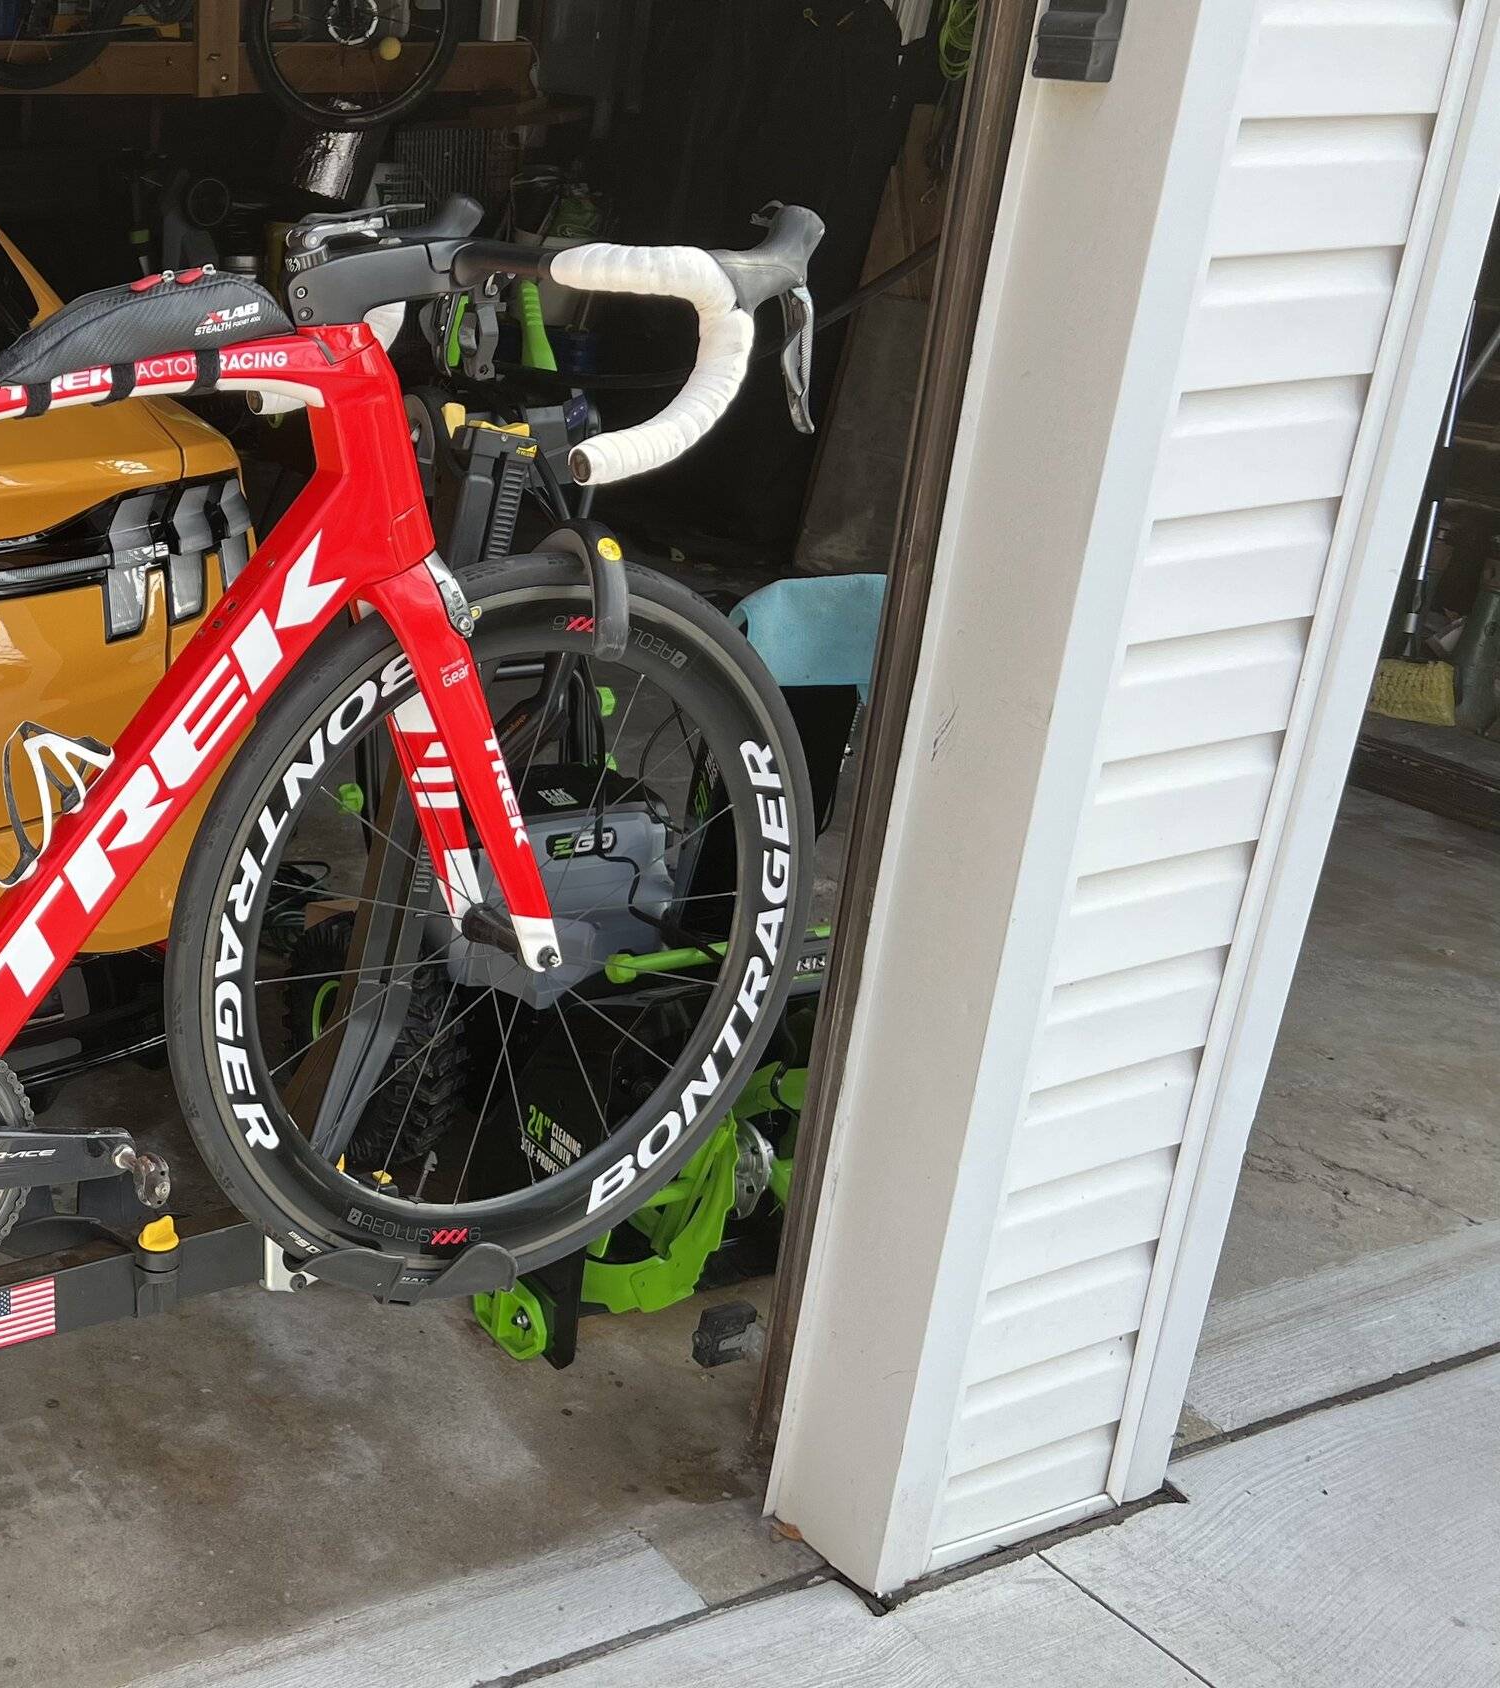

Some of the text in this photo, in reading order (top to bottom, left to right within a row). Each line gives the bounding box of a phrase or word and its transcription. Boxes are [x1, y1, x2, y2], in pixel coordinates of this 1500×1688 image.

[194, 320, 231, 336] STEALTH
[203, 302, 259, 326] XLAB
[440, 656, 465, 674] Samsung
[442, 663, 470, 688] Gear
[484, 728, 531, 848] TREK
[214, 652, 418, 1150] BONTRAGER
[586, 740, 791, 1215] BONTRAGER
[550, 1136, 572, 1167] WIDTH
[551, 1121, 582, 1159] CLEARING
[359, 1214, 432, 1244] AEOLUS
